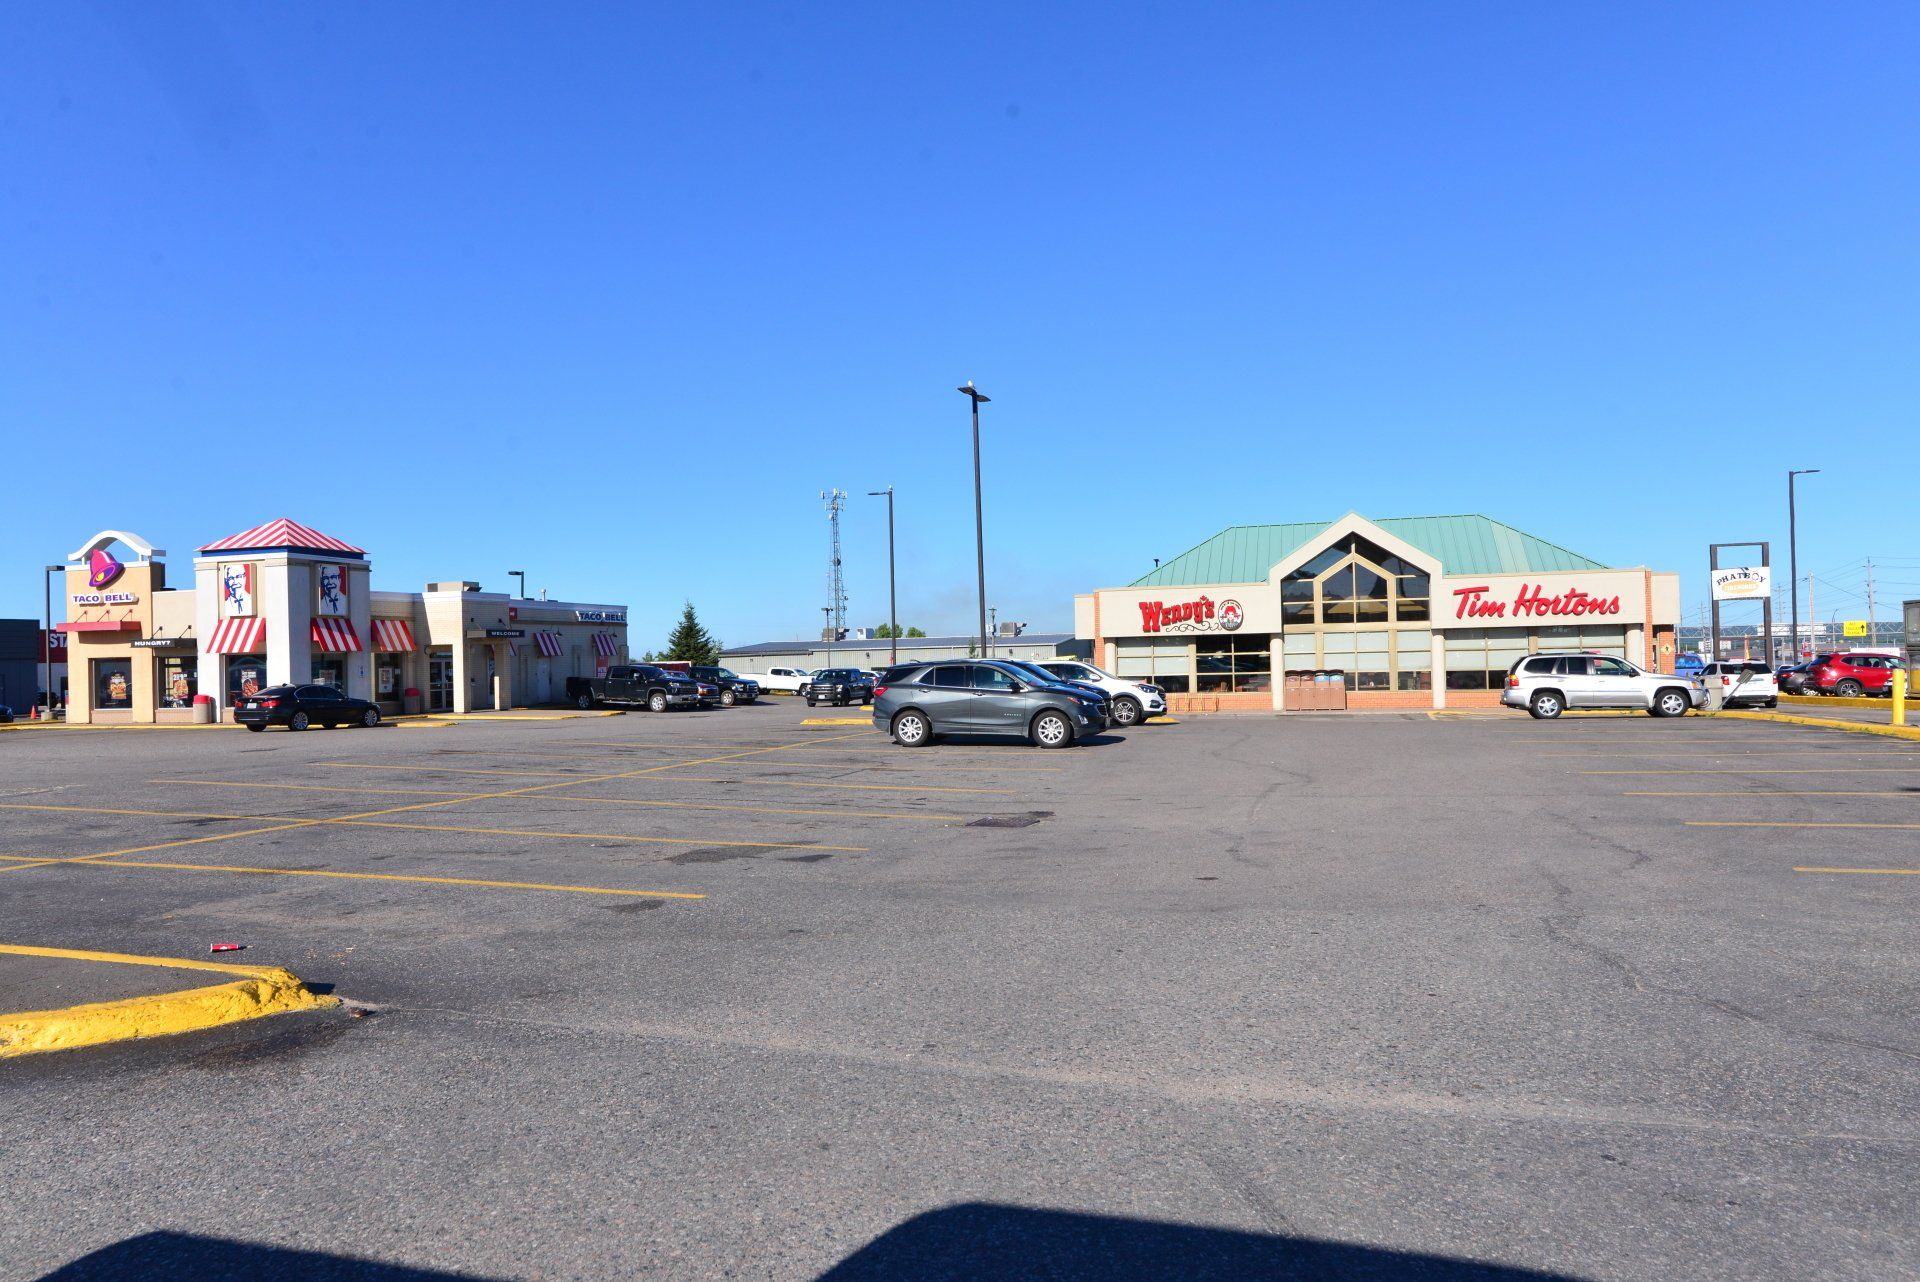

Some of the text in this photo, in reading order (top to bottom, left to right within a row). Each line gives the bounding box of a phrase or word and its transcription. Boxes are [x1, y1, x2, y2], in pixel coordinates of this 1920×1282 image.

[73, 593, 132, 603] TACO BELL
[1453, 583, 1621, 619] Tim Hortons
[579, 612, 626, 622] TACO BELL
